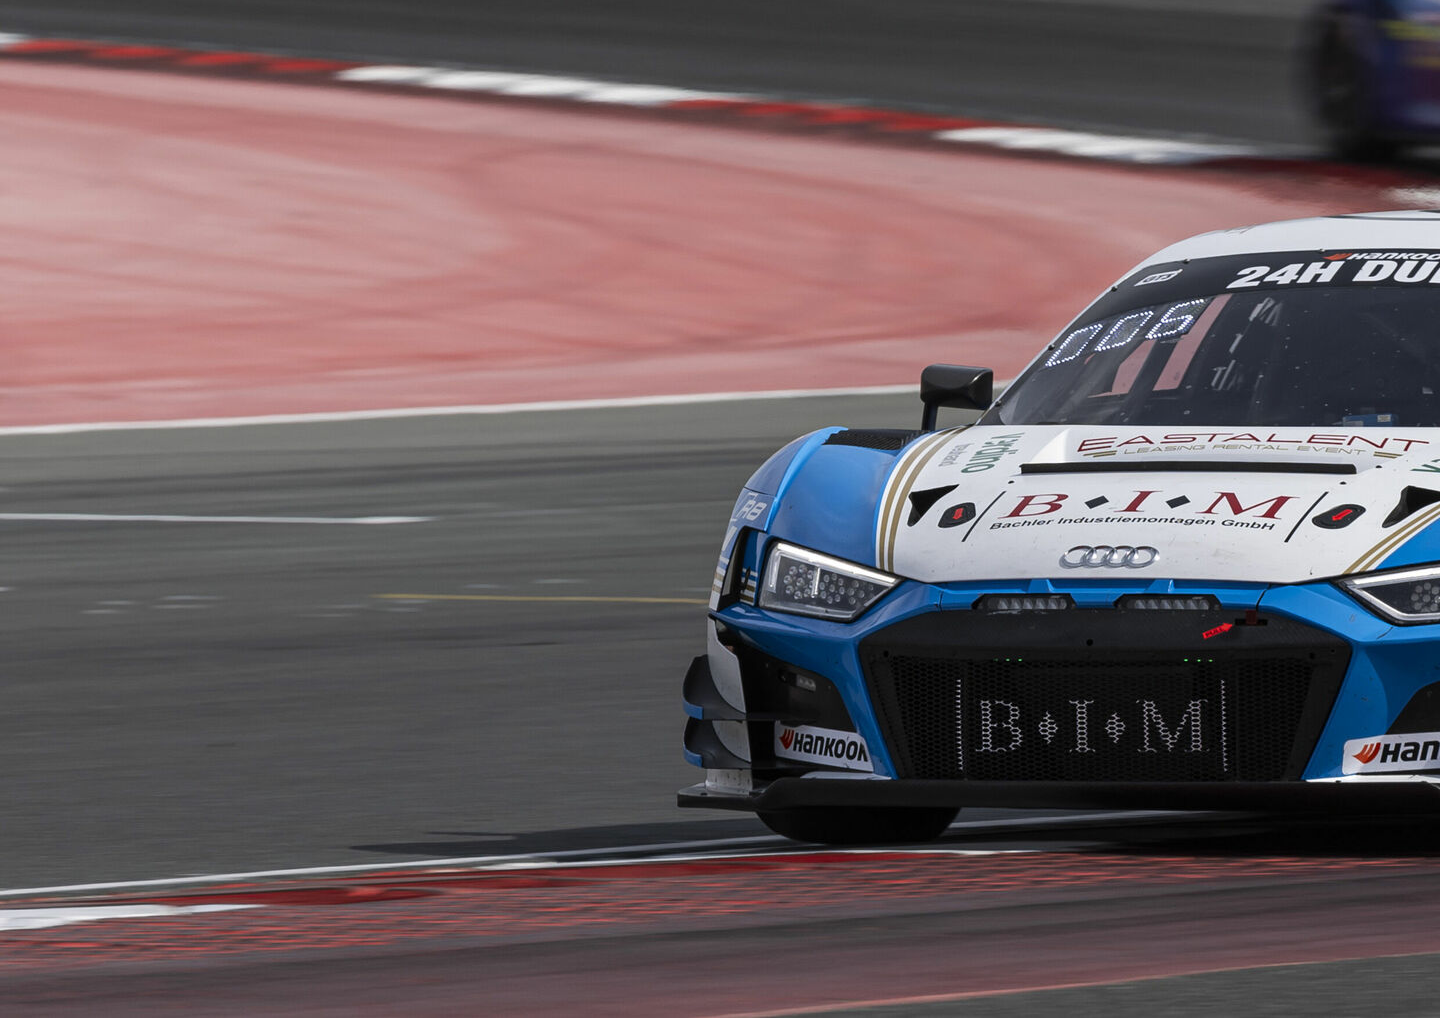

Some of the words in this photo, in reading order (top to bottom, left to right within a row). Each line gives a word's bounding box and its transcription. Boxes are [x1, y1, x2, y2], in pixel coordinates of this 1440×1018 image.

[1226, 261, 1346, 289] 24H
[1077, 433, 1430, 453] EASTALENT
[1123, 445, 1206, 455] LEASING
[1296, 446, 1366, 455] EVENT
[736, 499, 768, 521] R8
[989, 518, 1055, 530] Bachler
[1057, 516, 1218, 526] Industriemontagen
[1221, 519, 1276, 531] GmbH
